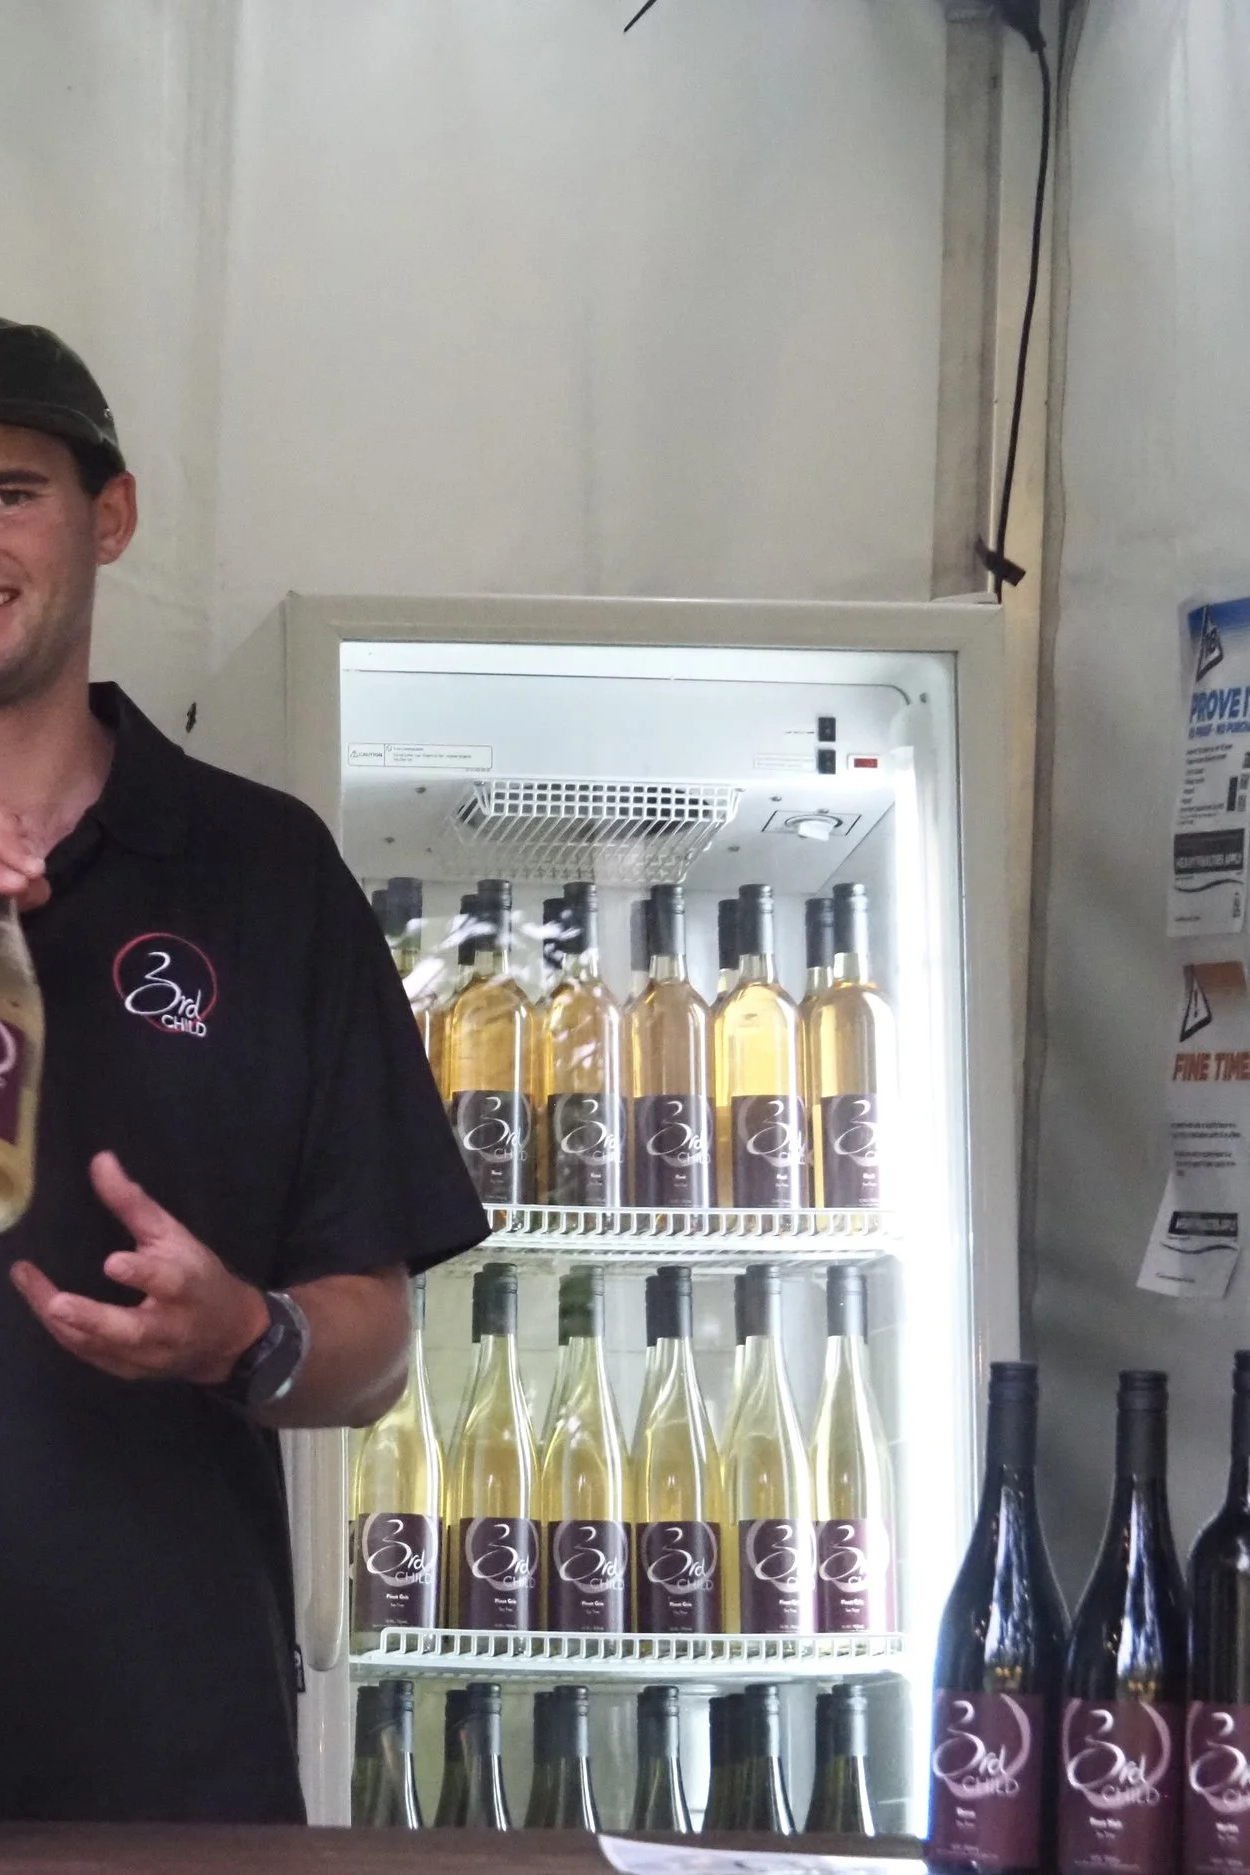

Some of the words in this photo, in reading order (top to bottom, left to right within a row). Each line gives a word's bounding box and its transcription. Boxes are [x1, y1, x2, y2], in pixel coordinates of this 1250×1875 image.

[1190, 687, 1242, 723] PROVE
[124, 951, 202, 1021] 3rd
[160, 1013, 208, 1038] CHILD
[1172, 1052, 1212, 1082] FINE
[463, 1096, 522, 1151] 3rd
[493, 1147, 529, 1163] CHD
[366, 1518, 427, 1575] 3rd
[471, 1523, 531, 1579] 3rd
[559, 1526, 618, 1582] 3rd
[647, 1526, 707, 1583] 3rd
[394, 1570, 432, 1586] CHILD
[502, 1575, 536, 1589] CHILD
[677, 1578, 714, 1592] CHILD
[933, 1699, 1008, 1778] 3rd
[1067, 1708, 1148, 1790] 3rd
